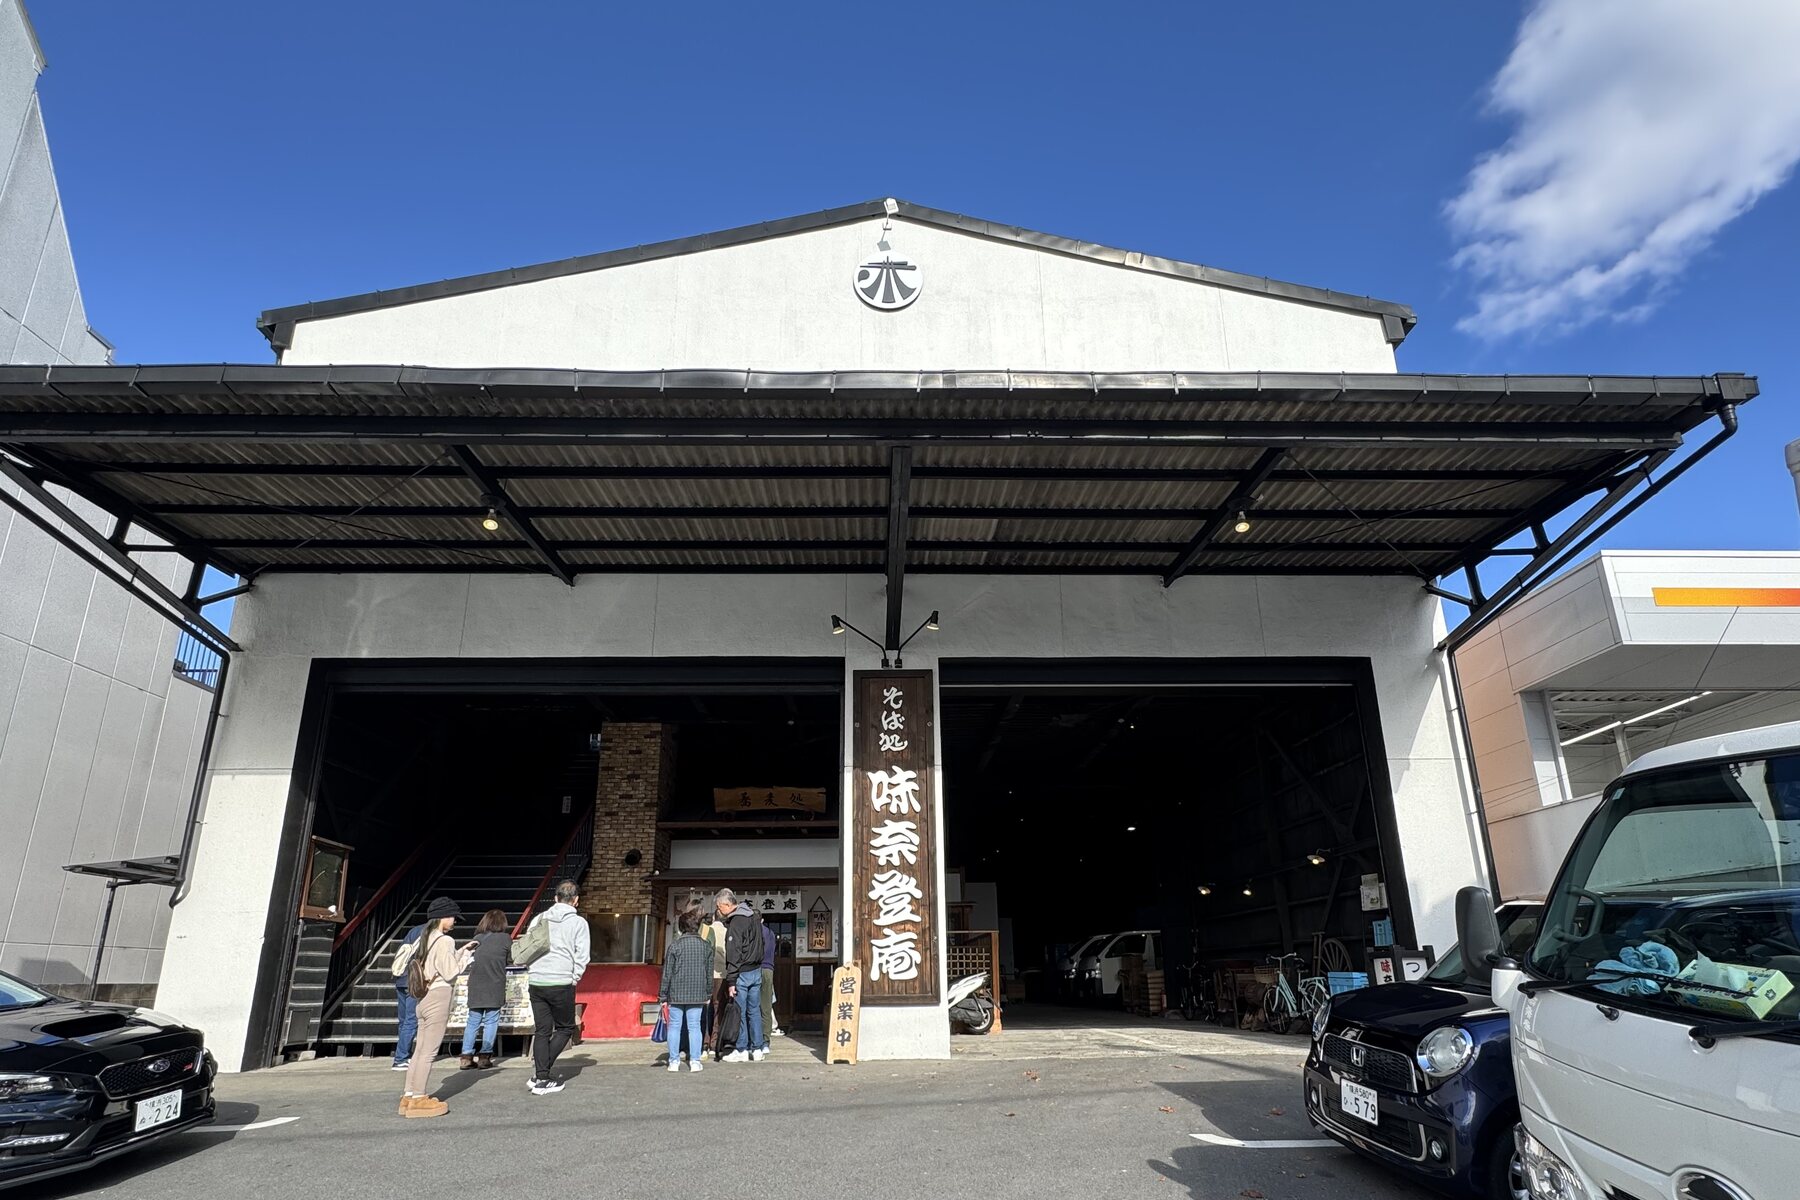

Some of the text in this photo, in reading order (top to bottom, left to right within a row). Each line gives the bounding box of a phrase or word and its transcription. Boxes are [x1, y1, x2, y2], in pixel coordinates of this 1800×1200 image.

[879, 686, 909, 753] そば処
[867, 765, 922, 982] 味奈登庵
[835, 976, 857, 1047] 営業中
